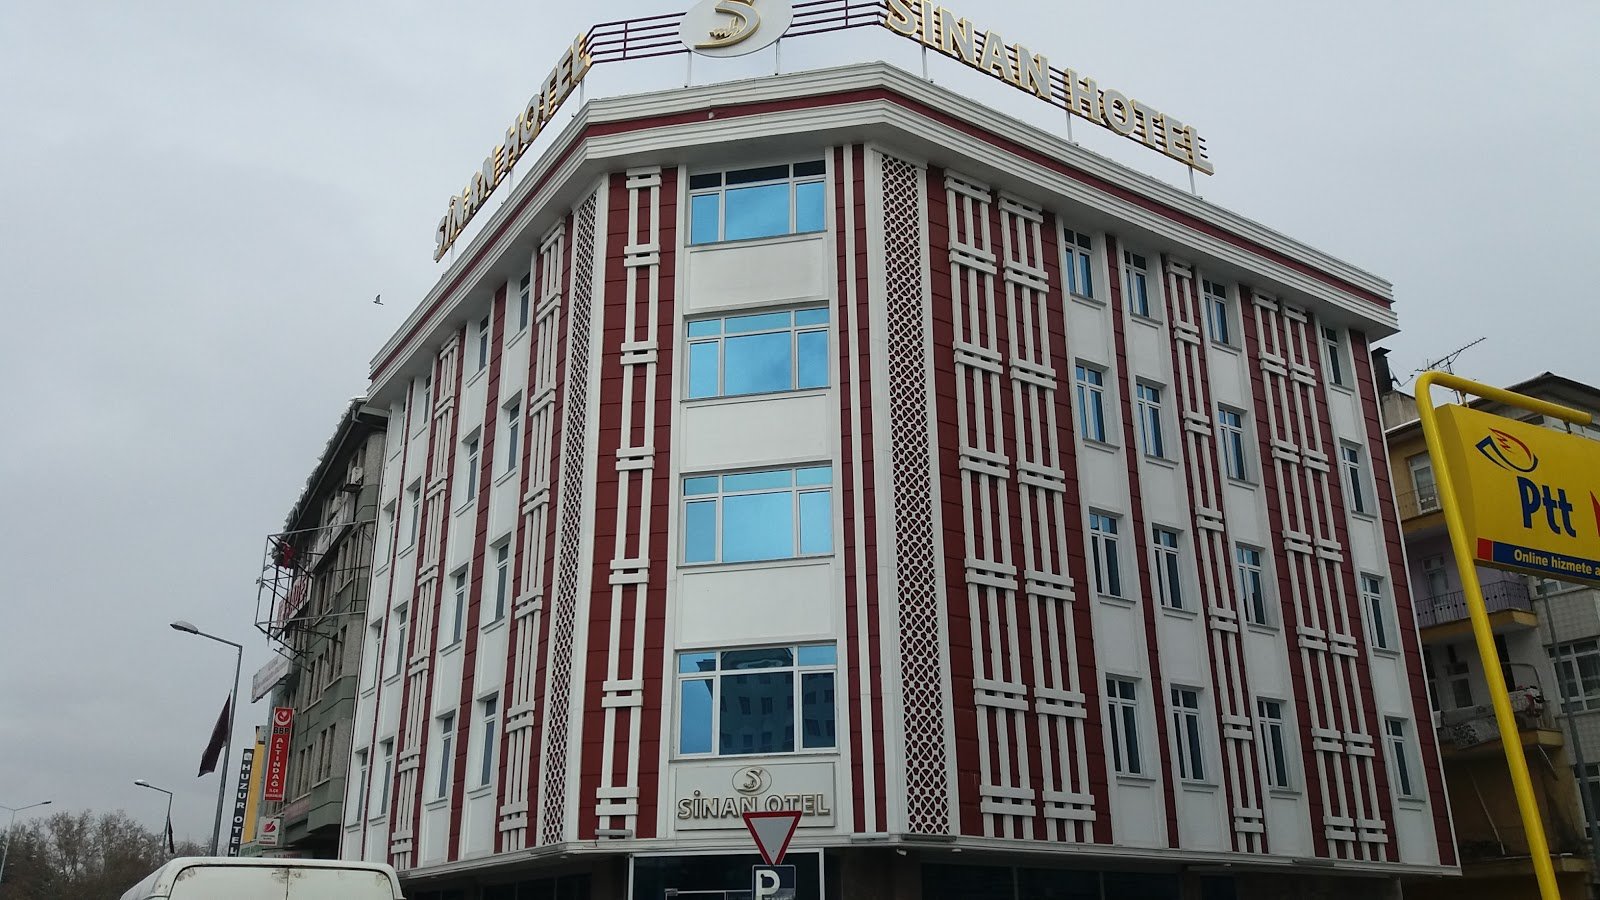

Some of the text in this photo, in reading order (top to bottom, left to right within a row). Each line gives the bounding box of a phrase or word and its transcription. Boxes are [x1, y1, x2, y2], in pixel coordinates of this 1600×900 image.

[502, 32, 592, 172] HOTEL
[1063, 67, 1214, 176] HOTEL
[1517, 475, 1577, 538] Ptt
[1514, 549, 1548, 567] Online
[1551, 556, 1592, 574] hizmete
[273, 727, 290, 735] BBP
[230, 764, 251, 855] HUZUR OTEL
[677, 790, 831, 819] SİNAN OTEL
[756, 870, 780, 900] P
